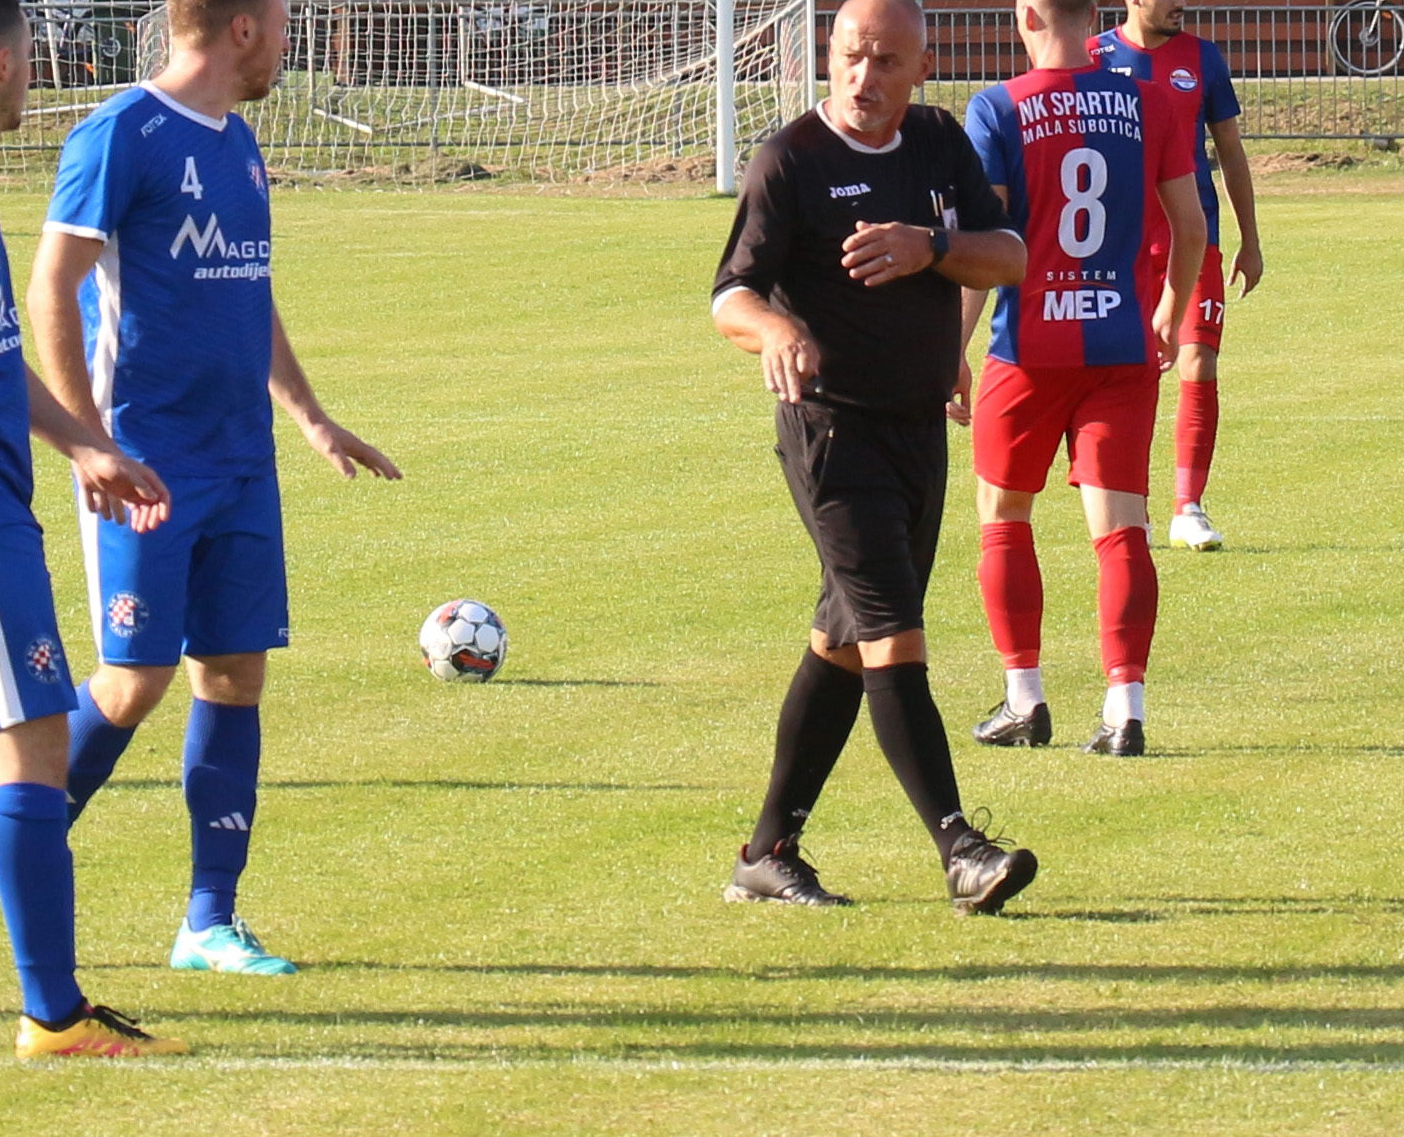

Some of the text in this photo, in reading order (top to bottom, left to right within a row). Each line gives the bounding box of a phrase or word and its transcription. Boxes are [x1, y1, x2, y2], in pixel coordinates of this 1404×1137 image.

[1017, 91, 1140, 126] NK SPARTAK
[1022, 118, 1142, 145] MALA SUBOTICA
[180, 156, 204, 200] 4
[829, 182, 872, 199] Joma
[1058, 147, 1108, 258] 8
[1046, 270, 1117, 281] SISTEM
[1043, 290, 1122, 321] MEP
[1199, 298, 1224, 325] 17
